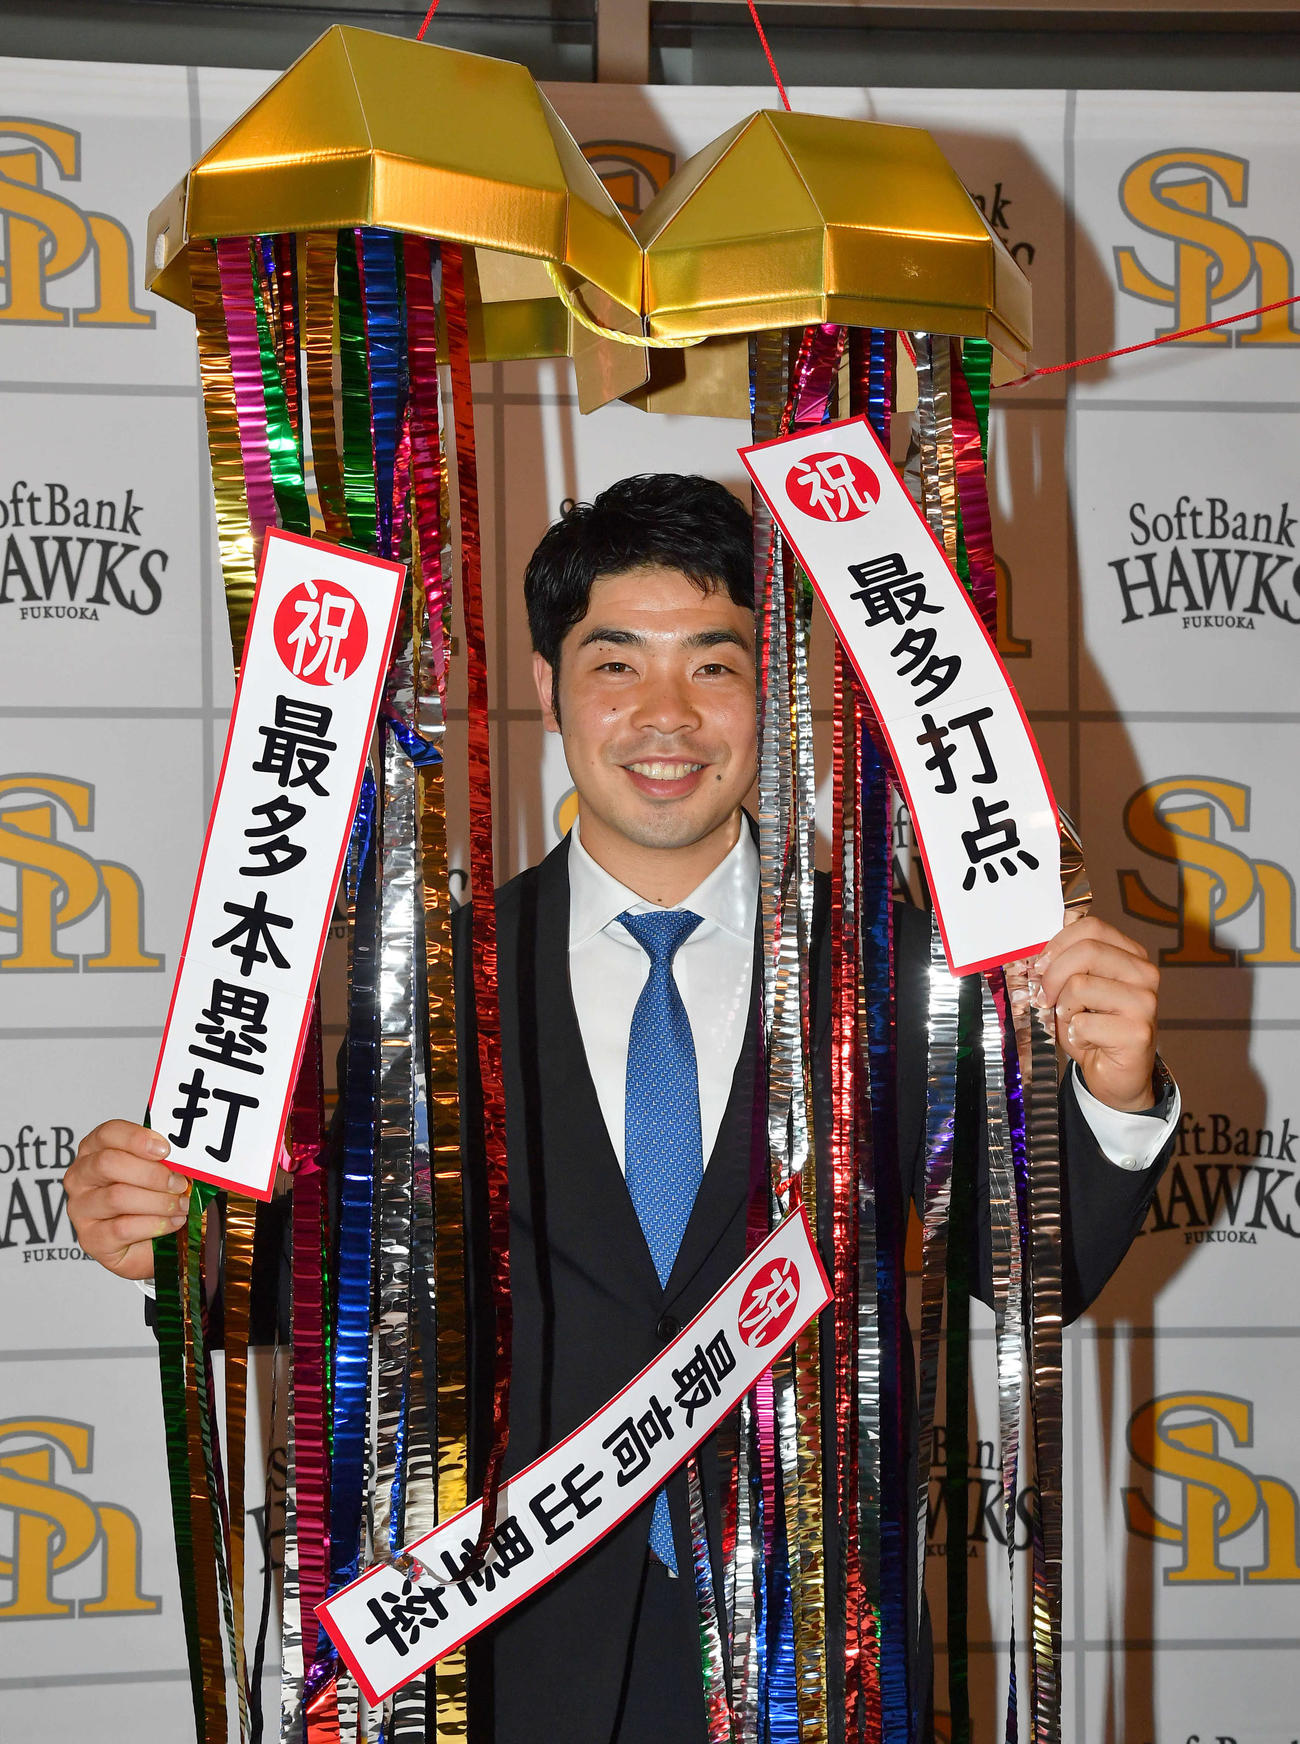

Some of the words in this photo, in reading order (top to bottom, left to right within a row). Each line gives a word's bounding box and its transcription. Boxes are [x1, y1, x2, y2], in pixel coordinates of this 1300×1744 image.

[1129, 496, 1298, 548] SoftBank
[0, 532, 169, 616] AWKS
[19, 606, 100, 621] FUKUOKA
[287, 579, 355, 686] 祝
[1182, 615, 1255, 630] FUKUOKA
[790, 454, 878, 522] 祝
[846, 552, 1040, 891] 最多打点
[168, 694, 338, 1163] 最多本塁打
[1177, 1112, 1298, 1163] ftBank
[1184, 1230, 1257, 1244] FUKUOKA
[738, 1256, 798, 1348] 祝
[365, 1329, 737, 1657] 最高出塁率
